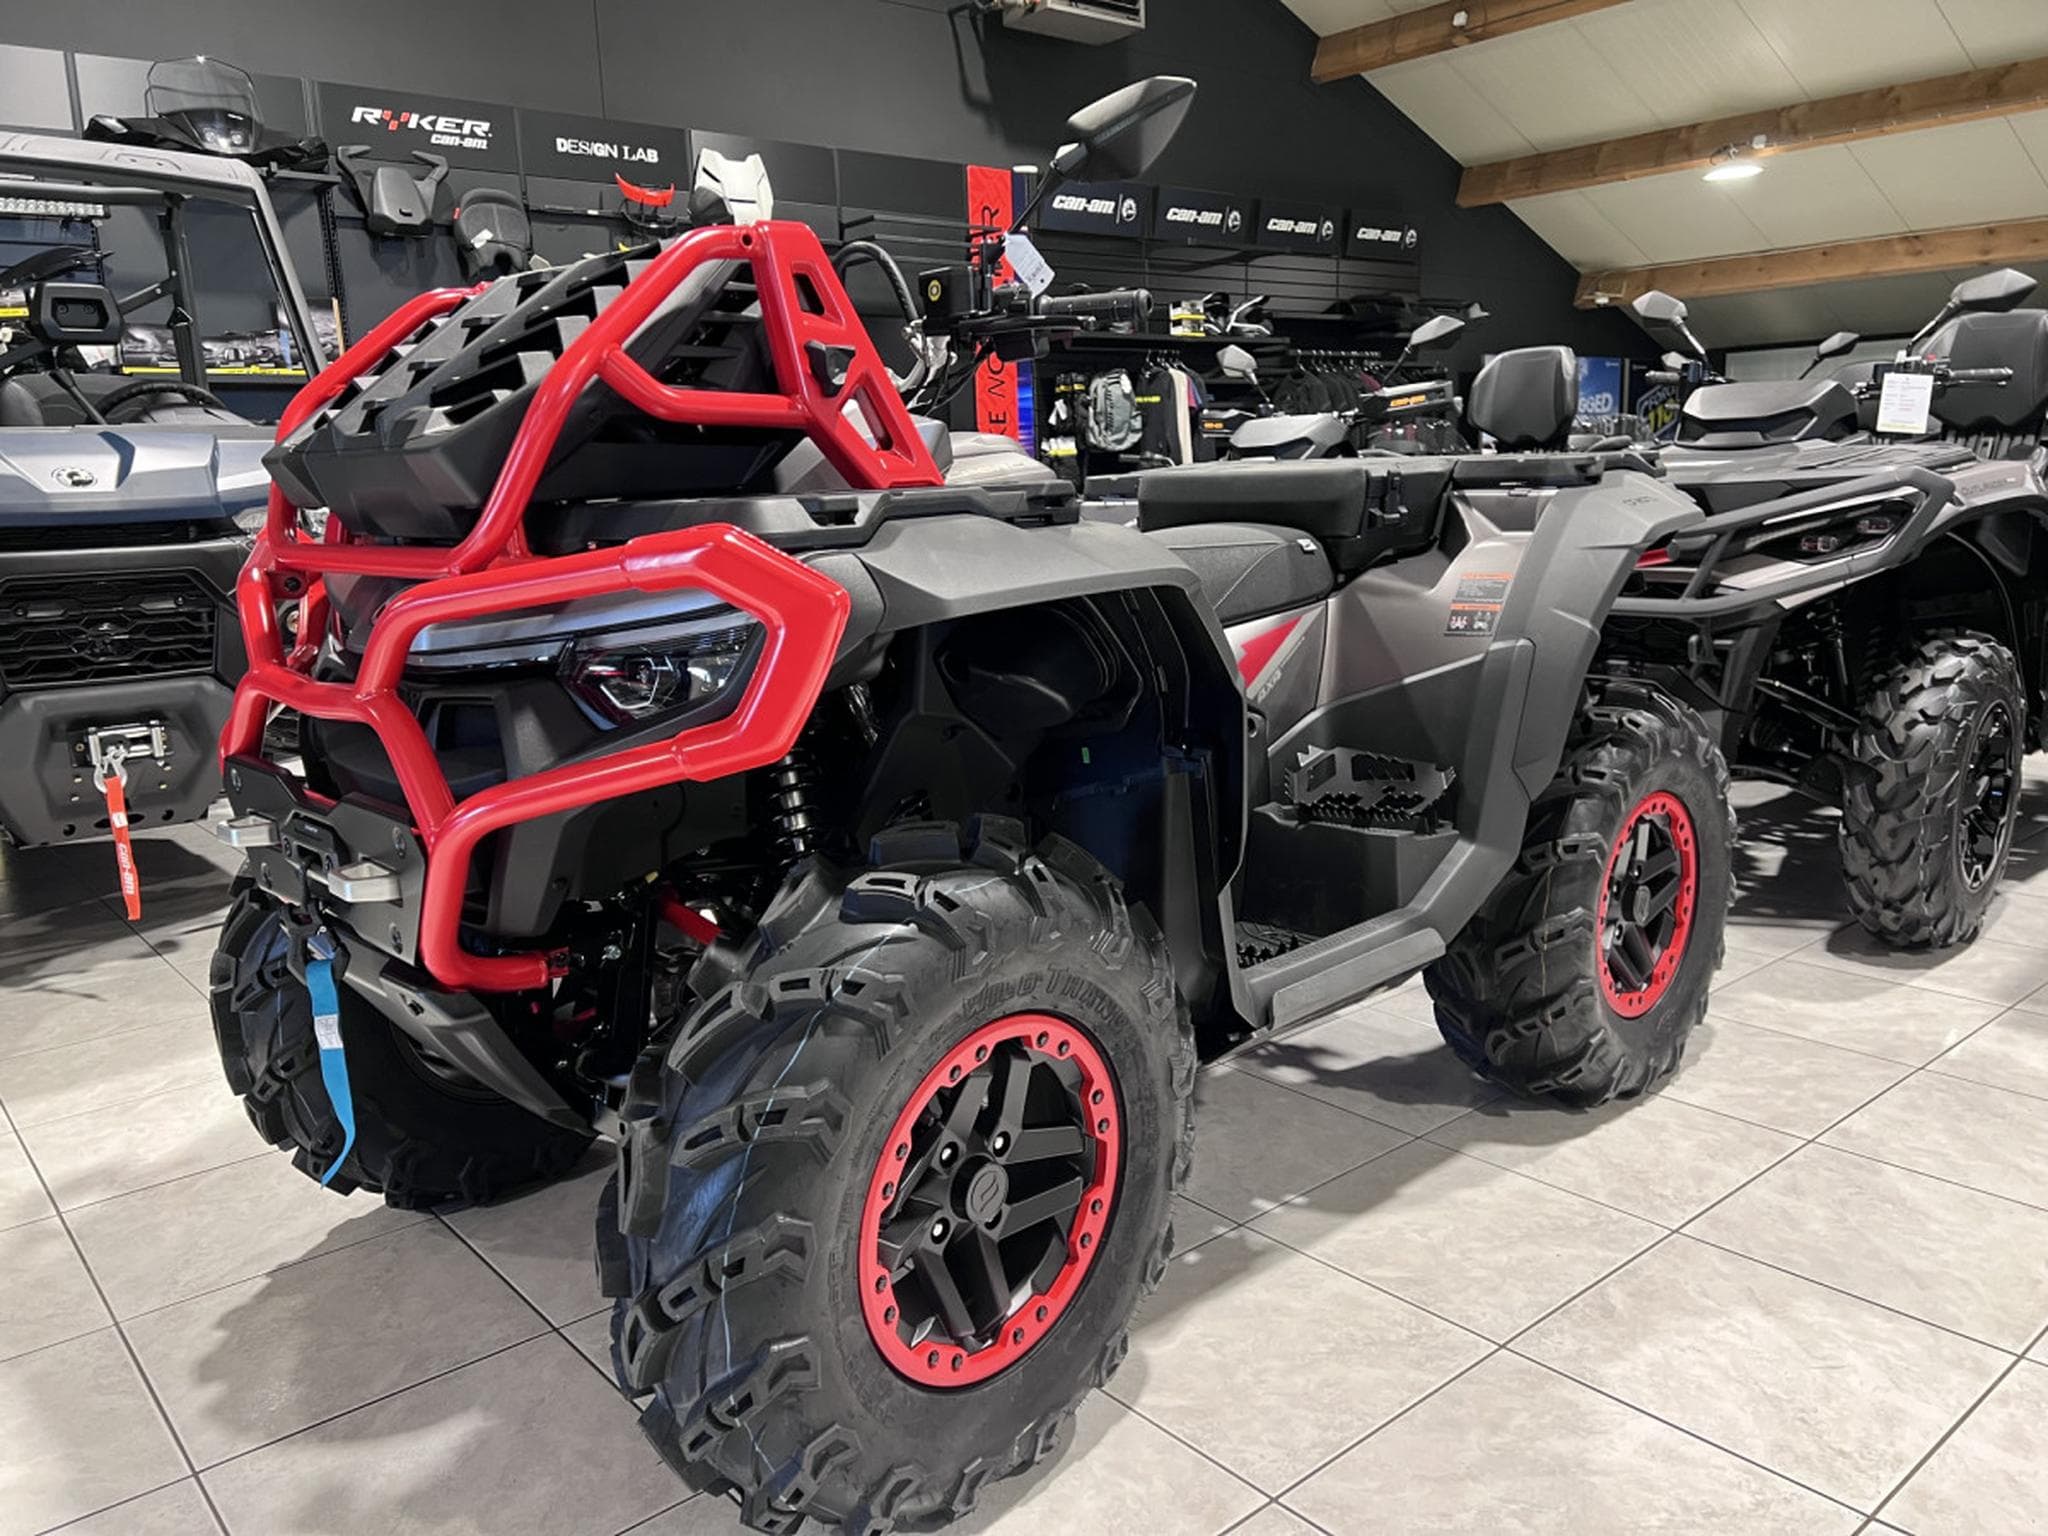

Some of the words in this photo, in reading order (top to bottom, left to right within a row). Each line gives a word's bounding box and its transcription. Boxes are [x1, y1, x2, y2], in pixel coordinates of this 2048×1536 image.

[351, 106, 493, 138] RYKER
[430, 133, 488, 149] can-am
[555, 137, 618, 159] DESIGN
[622, 145, 658, 163] LAB
[1052, 194, 1116, 214] can-am
[1166, 207, 1223, 225] can-am
[1266, 217, 1318, 234] can-am
[1356, 227, 1402, 242] can-am
